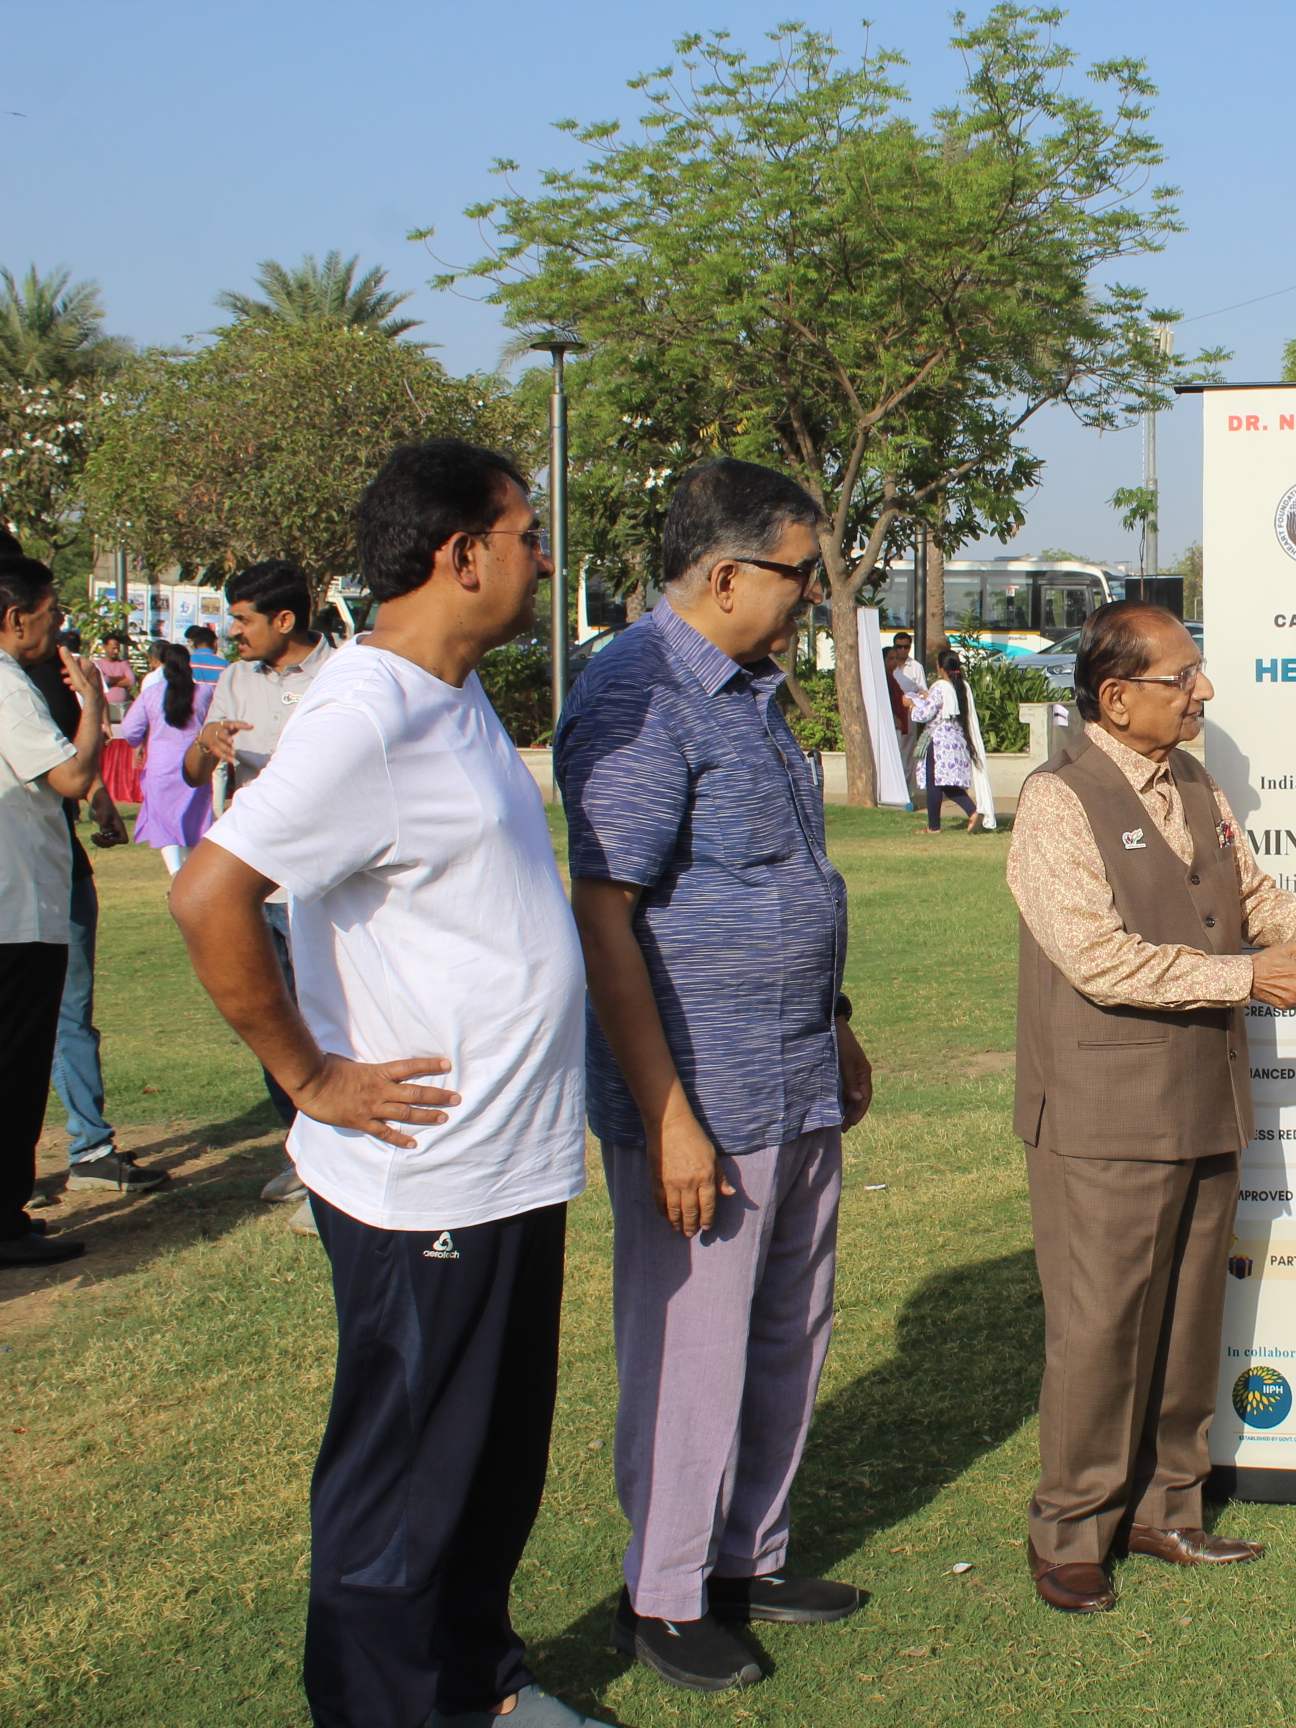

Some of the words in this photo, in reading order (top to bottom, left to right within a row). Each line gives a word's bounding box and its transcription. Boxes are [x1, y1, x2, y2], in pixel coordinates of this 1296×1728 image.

[1228, 414, 1268, 431] DR.
[1227, 1346, 1240, 1358] In
[1263, 1384, 1284, 1395] IIPH
